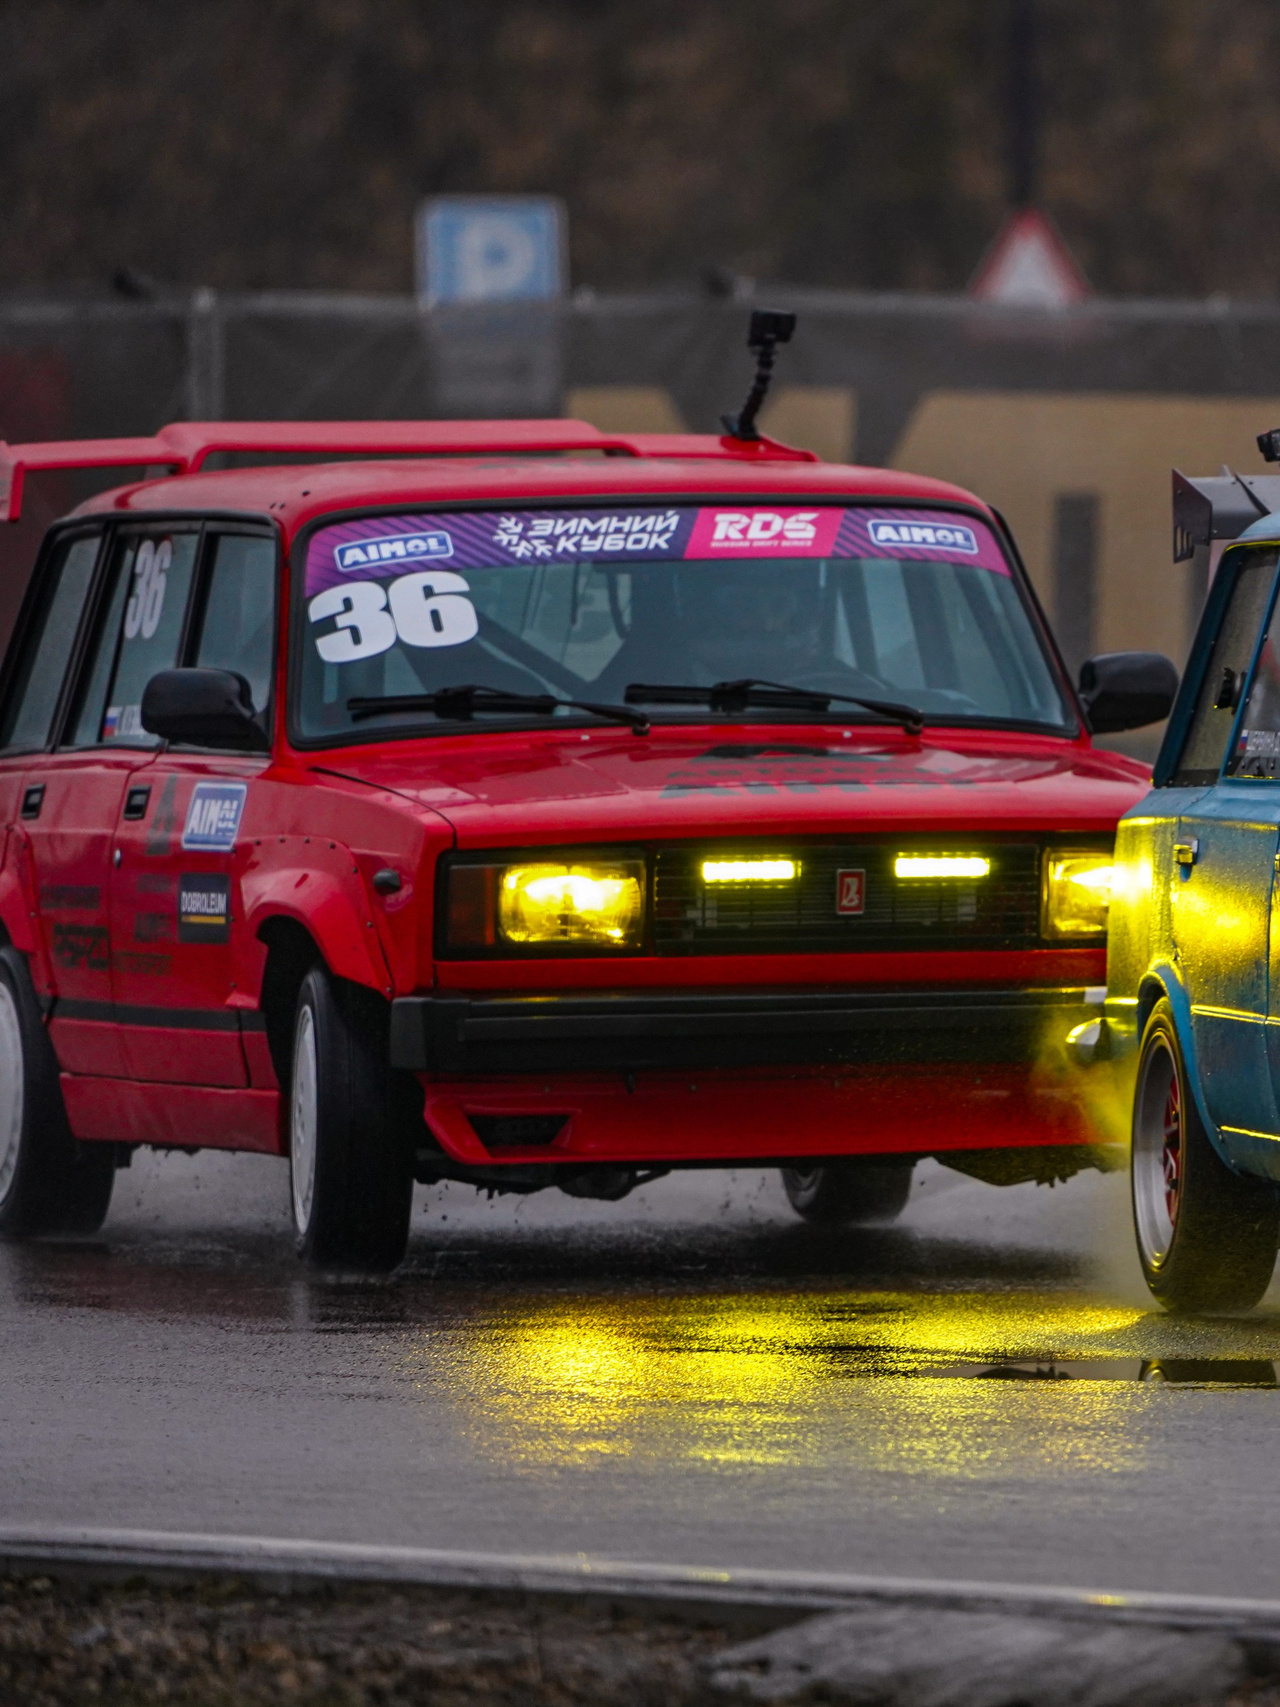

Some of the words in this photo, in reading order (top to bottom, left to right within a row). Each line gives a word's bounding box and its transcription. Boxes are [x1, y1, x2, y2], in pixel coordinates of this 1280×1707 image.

[527, 510, 680, 535] ЗИМНИЙ
[713, 512, 820, 541] RDS
[876, 524, 972, 545] AIMOL
[342, 535, 448, 567] AIMOL
[555, 531, 675, 553] КУБОК
[124, 539, 173, 639] 36
[308, 570, 479, 664] 36
[187, 799, 239, 837] AIMOL
[181, 891, 227, 915] DOBROLEUM
